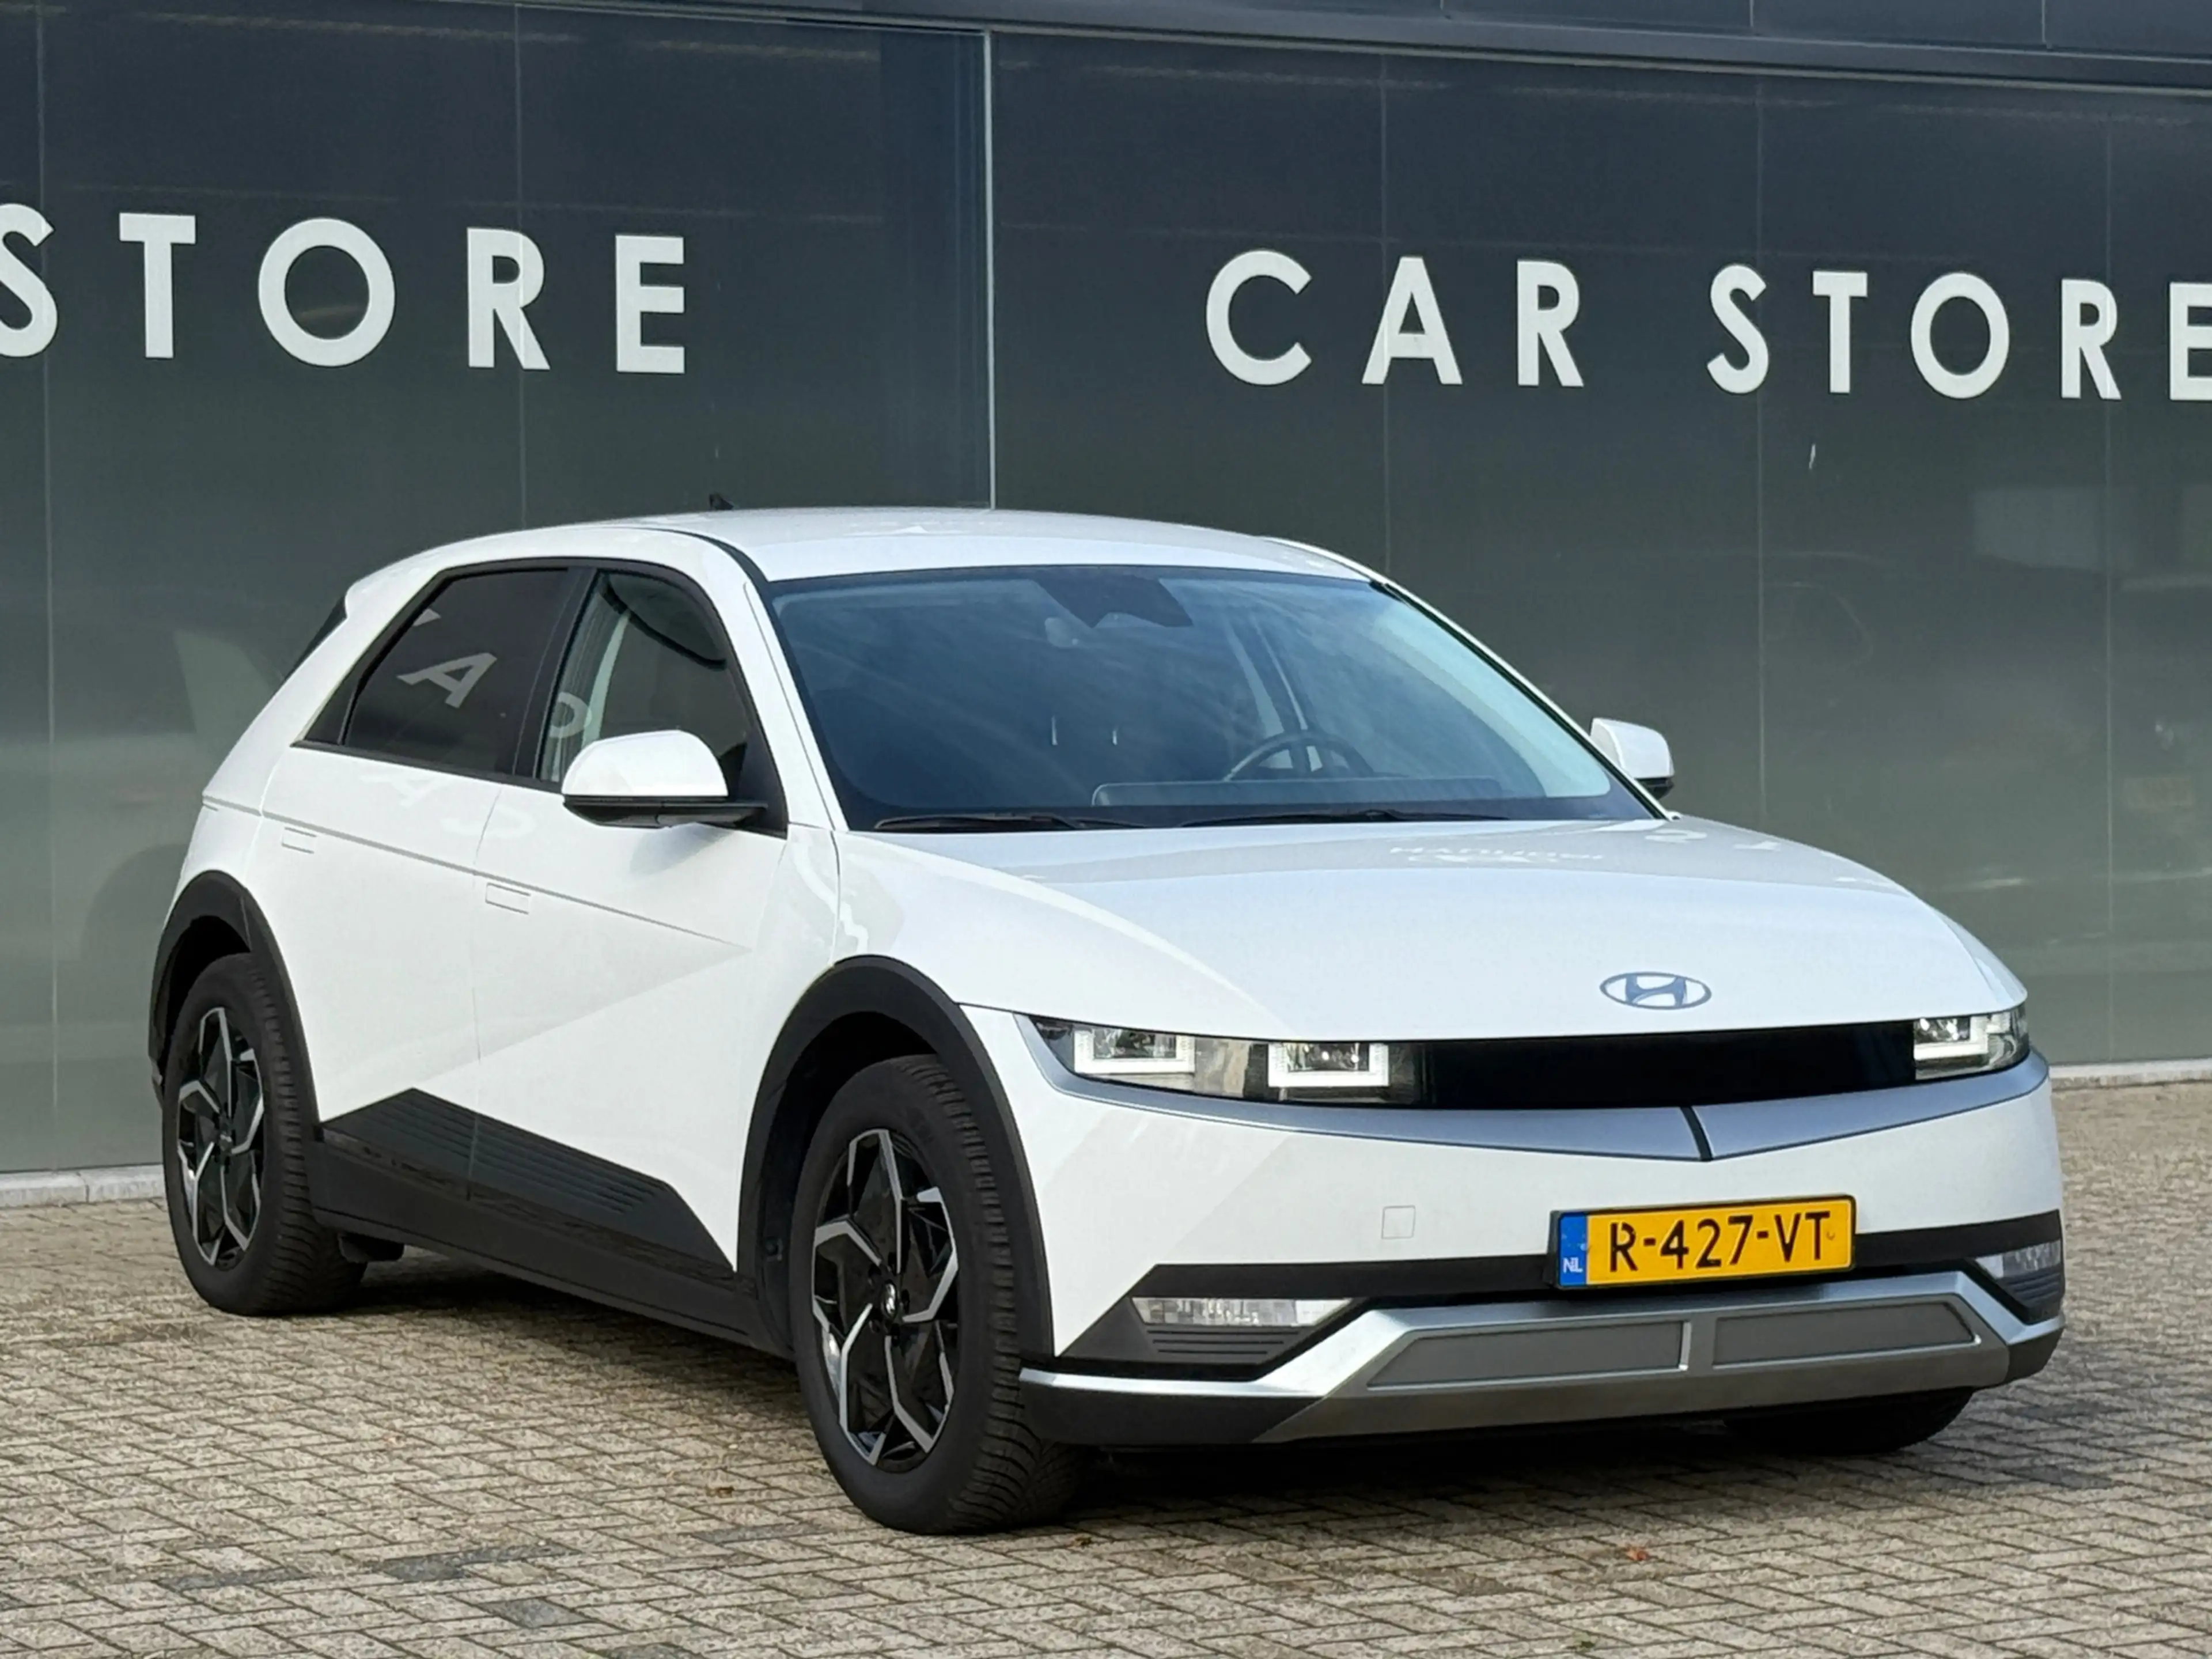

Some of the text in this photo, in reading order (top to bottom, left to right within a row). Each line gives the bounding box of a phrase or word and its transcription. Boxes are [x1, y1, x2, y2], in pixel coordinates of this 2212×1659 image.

[0, 203, 685, 373] STORE
[1206, 250, 2212, 400] CAR STORE
[1563, 1257, 1583, 1273] NL
[1609, 1211, 1831, 1272] R-427-VT
